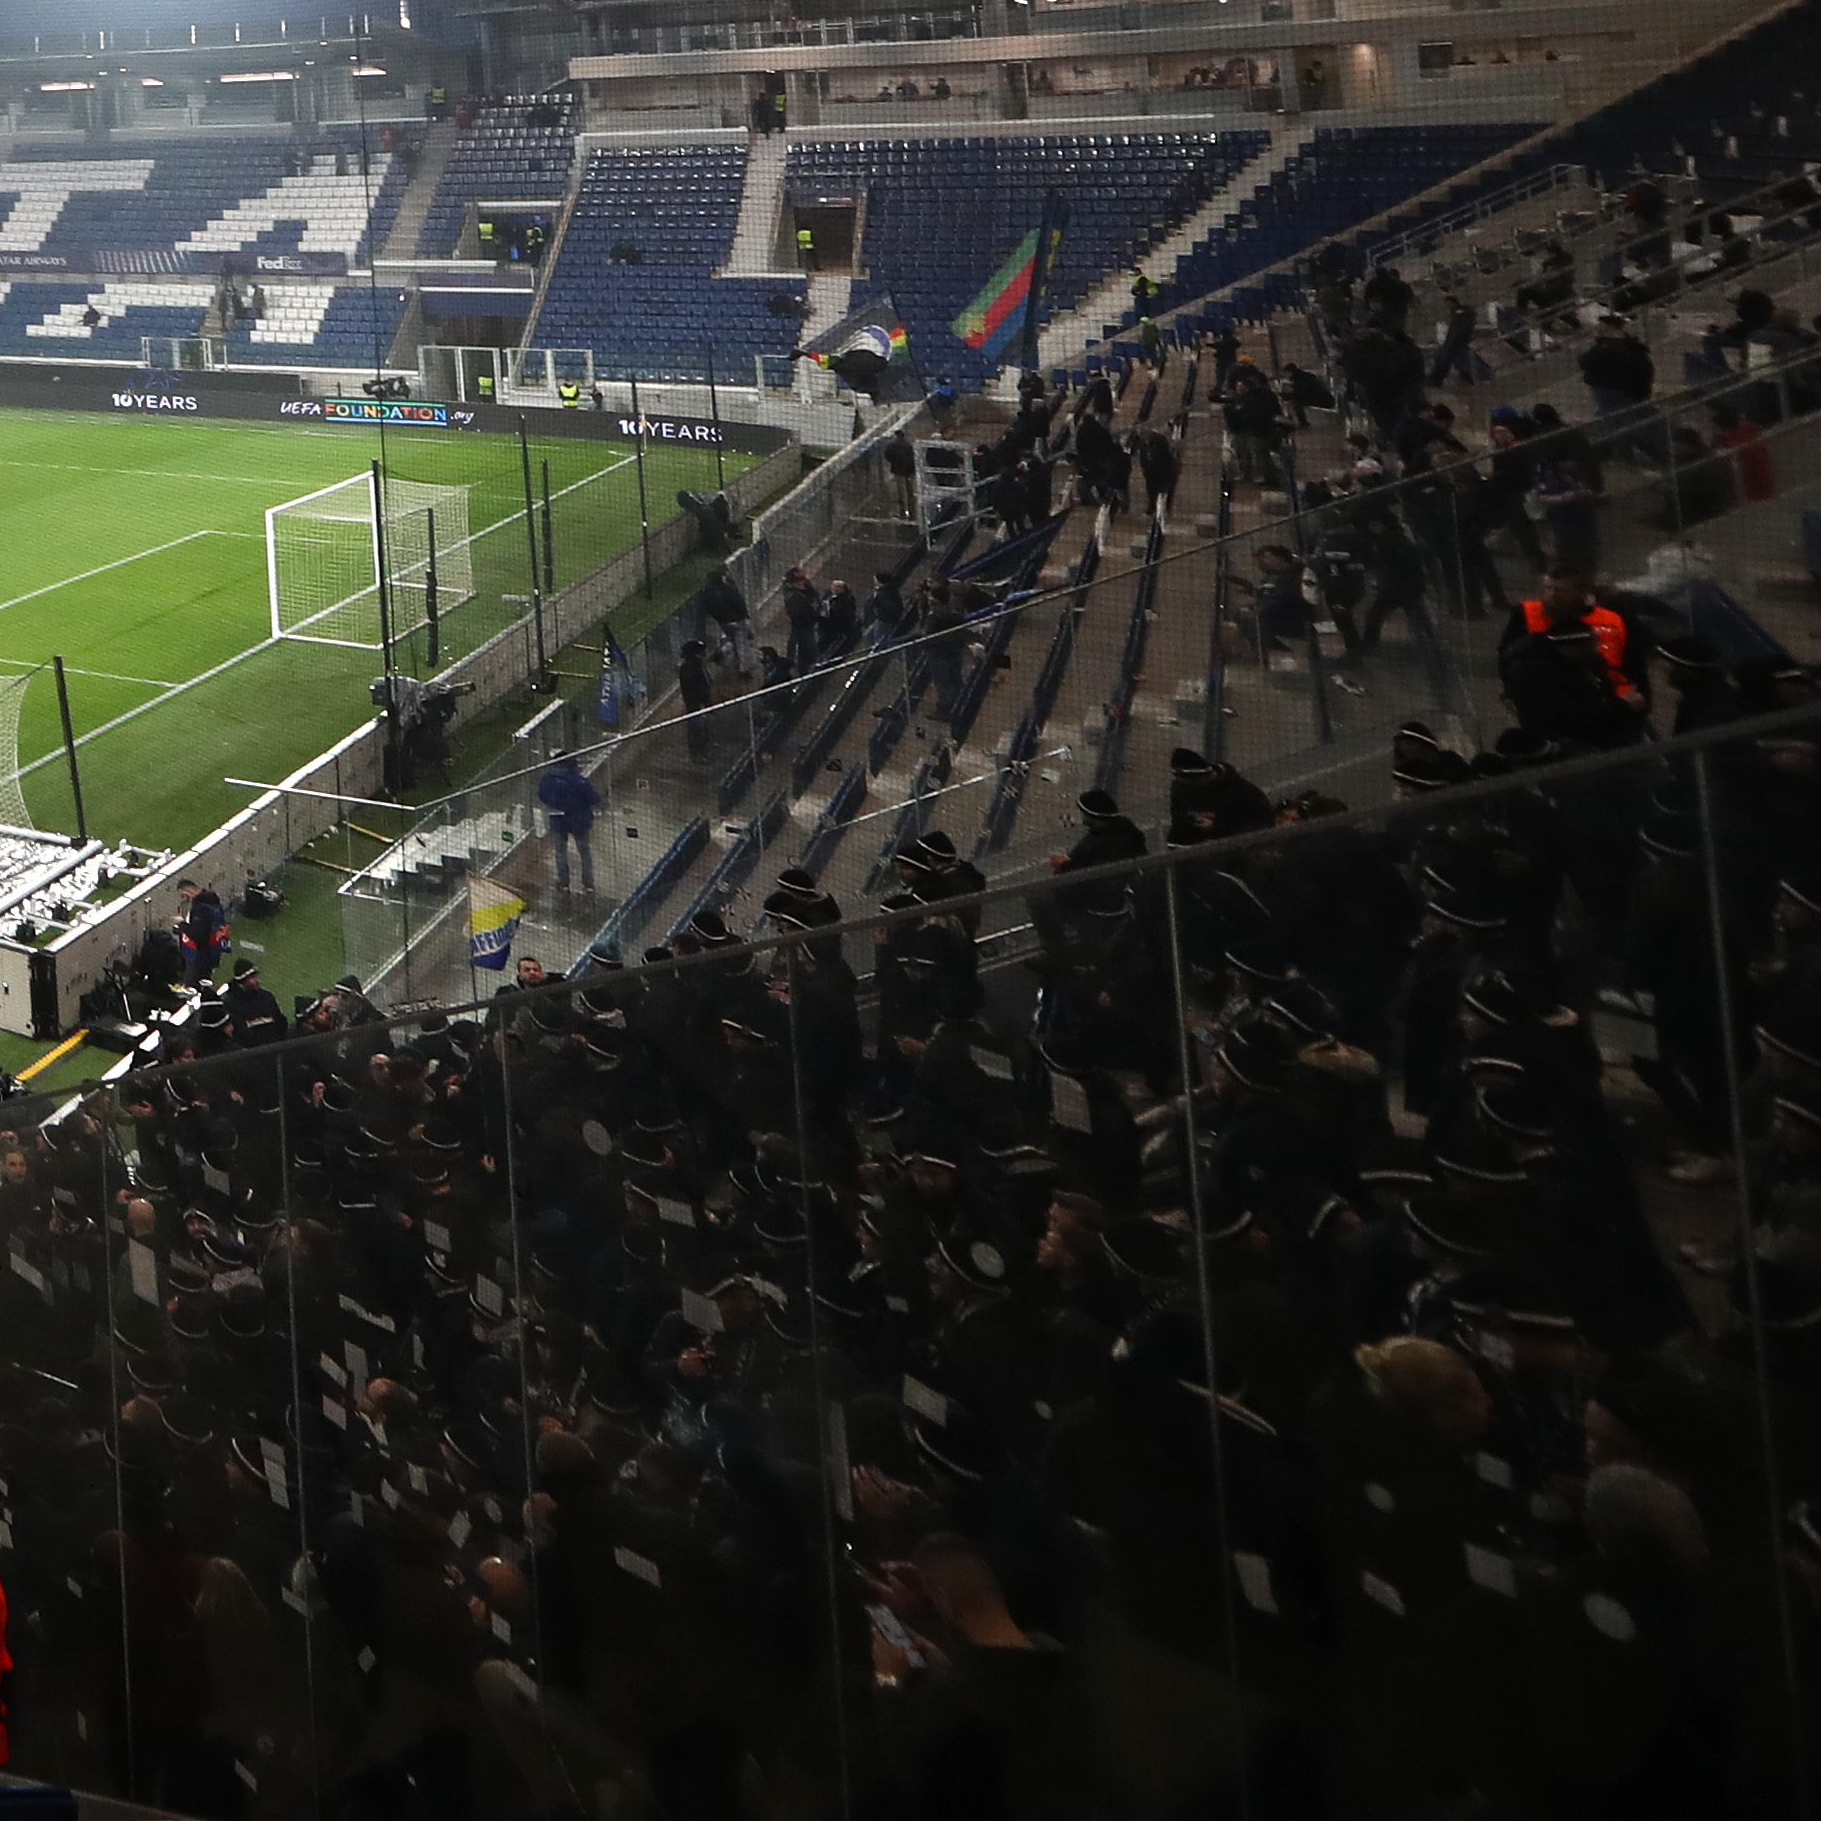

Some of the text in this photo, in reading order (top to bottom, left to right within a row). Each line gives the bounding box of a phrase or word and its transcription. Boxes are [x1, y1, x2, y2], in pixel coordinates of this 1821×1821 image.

[23, 256, 67, 267] AIRWAYS
[257, 255, 303, 270] FedEx
[280, 401, 322, 415] UEFA
[325, 404, 448, 422] FOUNDATION
